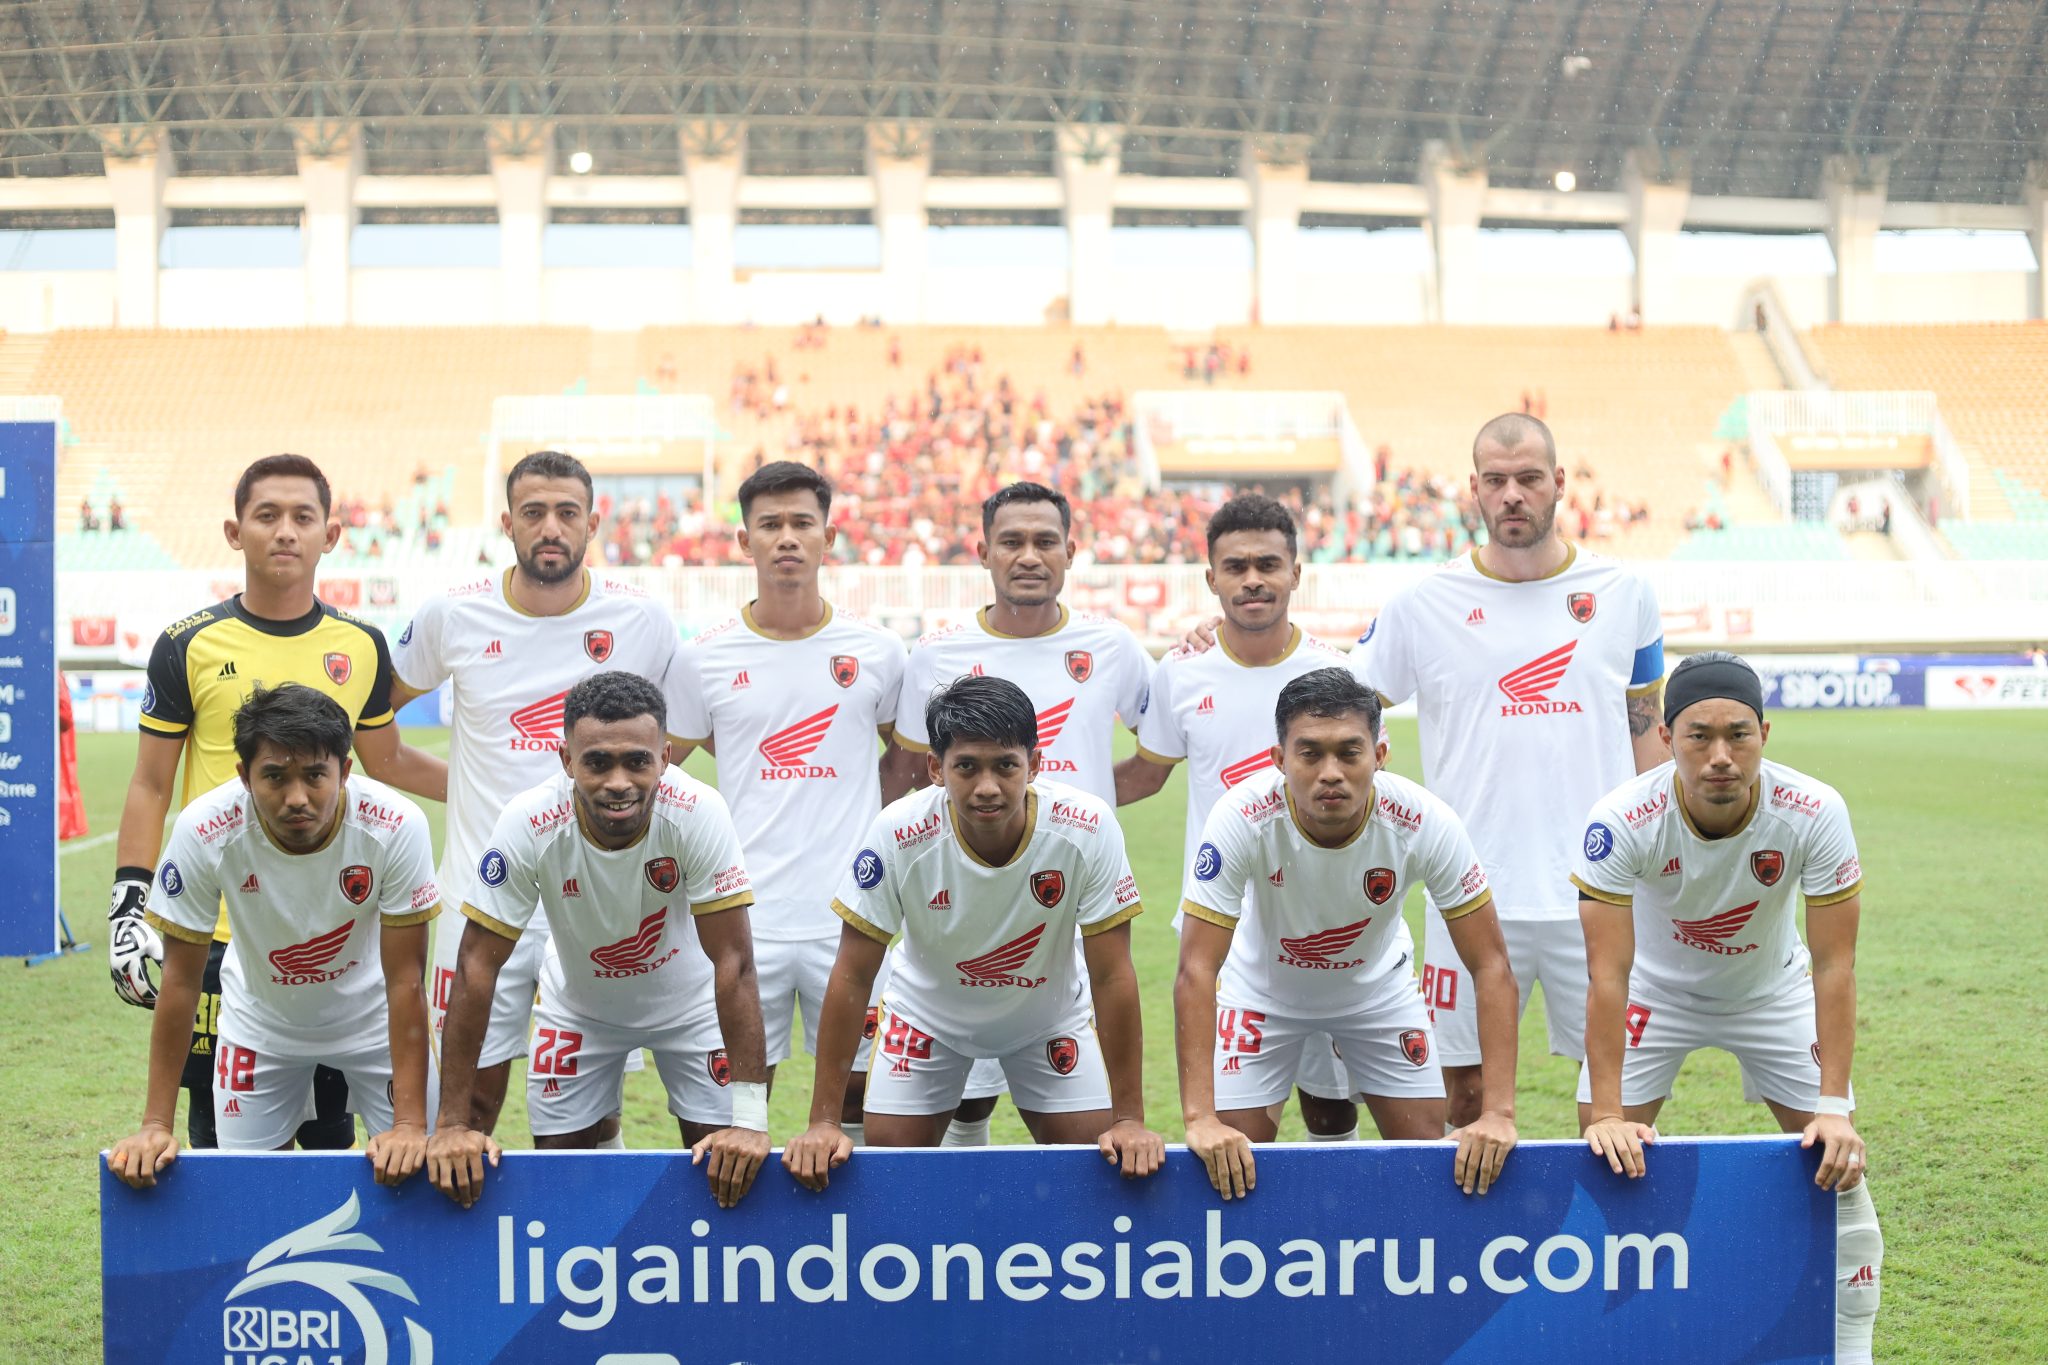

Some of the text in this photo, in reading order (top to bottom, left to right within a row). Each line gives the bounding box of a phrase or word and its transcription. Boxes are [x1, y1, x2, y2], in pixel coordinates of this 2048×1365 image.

[1500, 701, 1583, 716] HONDA
[509, 738, 566, 752] HON
[761, 766, 839, 780] HONDA
[657, 780, 697, 804] KALLA
[1240, 790, 1282, 817] KALLA
[1773, 785, 1821, 809] KALLA
[196, 804, 243, 837] KALLA
[358, 800, 404, 826] KALLA
[530, 800, 572, 828] KALLA
[1052, 801, 1099, 825] KALLA
[1379, 797, 1422, 825] KALLA
[1625, 792, 1667, 823] KALLA
[894, 813, 941, 842] KALLA
[1673, 931, 1760, 957] HONDA
[271, 960, 359, 986] HONDA
[593, 947, 680, 979] HONDA
[1278, 954, 1366, 970] HONDA
[960, 975, 1047, 990] HONDA
[1422, 963, 1458, 1011] 80
[1218, 1009, 1266, 1054] 45
[534, 1028, 583, 1075] 22
[217, 1045, 256, 1092] 48
[498, 1210, 1689, 1332] ligaindonesiabaru.com
[270, 1310, 339, 1349] BRI
